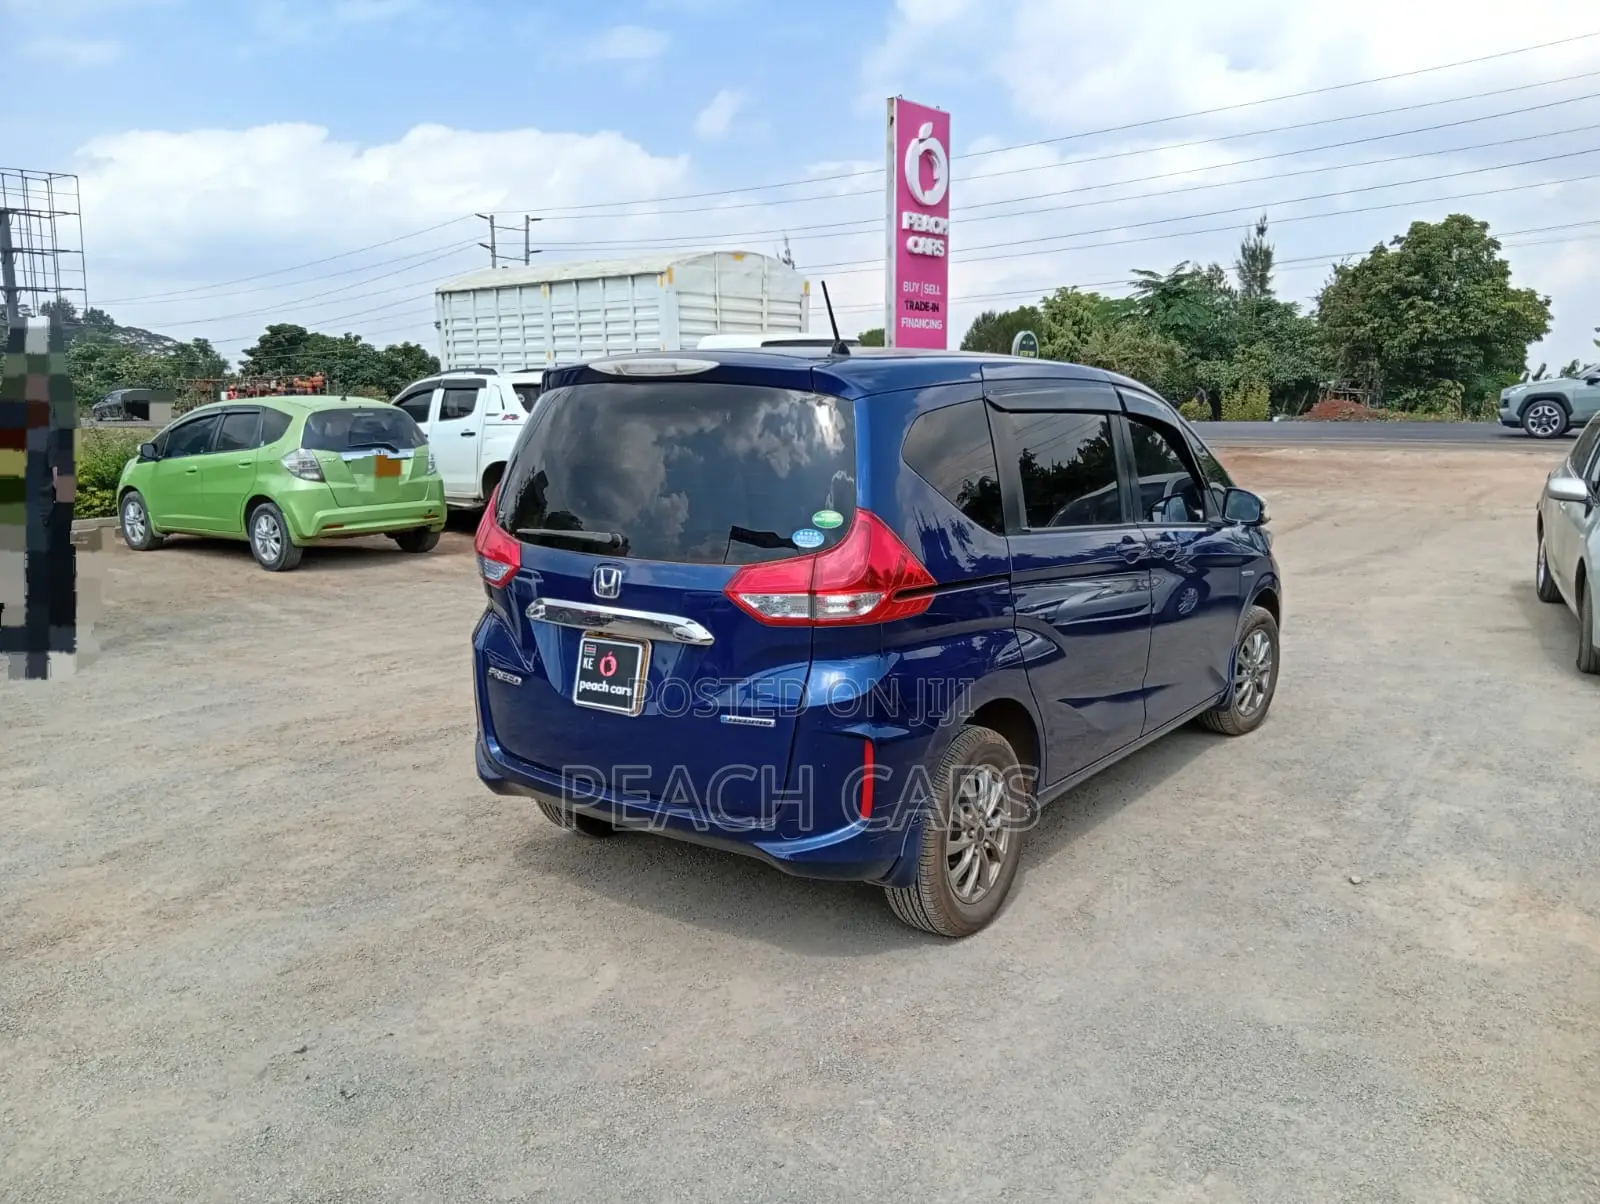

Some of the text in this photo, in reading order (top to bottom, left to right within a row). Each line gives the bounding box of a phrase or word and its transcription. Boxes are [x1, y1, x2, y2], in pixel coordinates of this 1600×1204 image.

[902, 211, 949, 235] PEACH
[907, 236, 945, 257] CARS
[903, 281, 941, 296] BUY SELL
[904, 300, 940, 313] TRADE-IN
[901, 317, 943, 330] FINANCING
[582, 657, 595, 670] KE
[579, 680, 633, 697] peach cars
